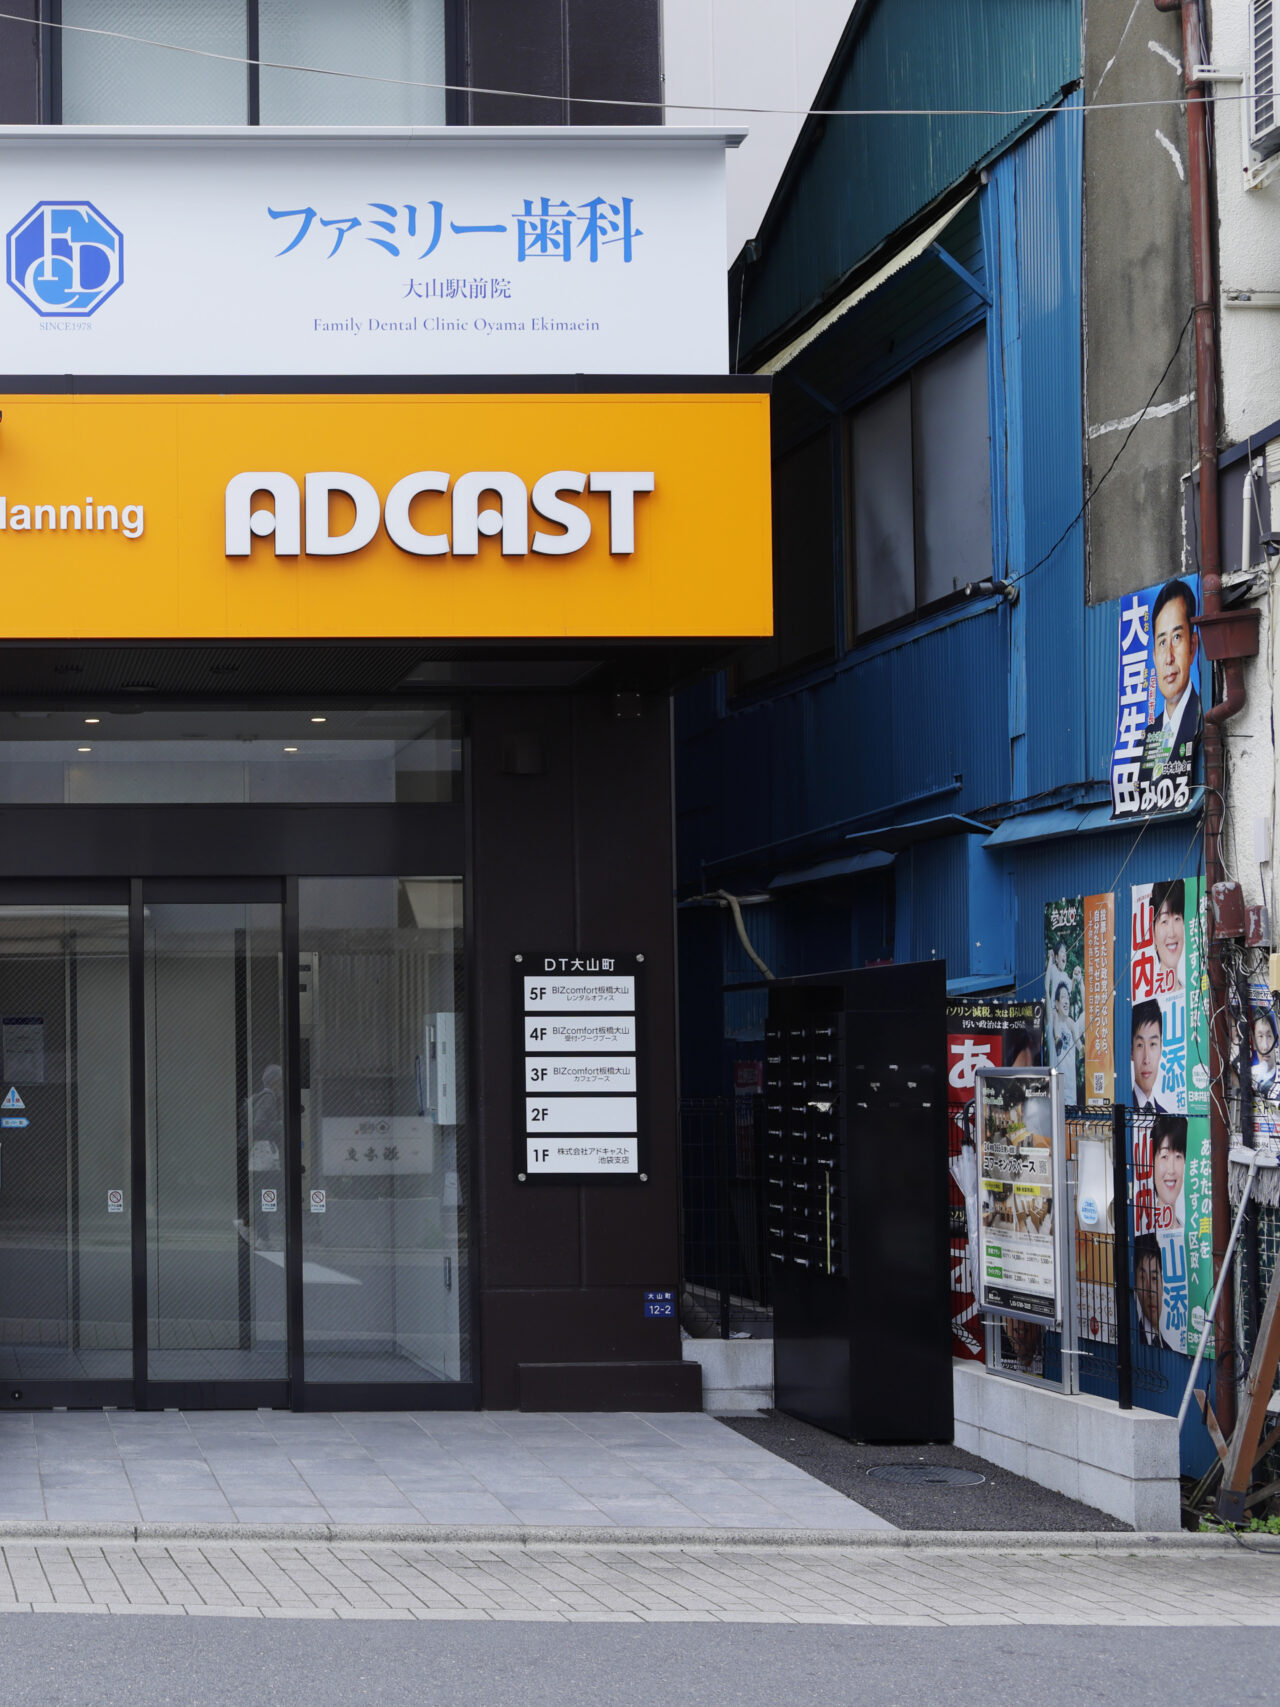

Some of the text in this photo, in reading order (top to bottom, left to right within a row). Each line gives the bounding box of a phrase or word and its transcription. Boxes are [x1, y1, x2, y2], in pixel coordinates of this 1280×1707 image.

[267, 196, 645, 264] ファミリー歯科
[402, 277, 512, 300] 大山駅前院
[39, 321, 93, 332] SINCE1978
[312, 318, 363, 336] Family
[367, 318, 418, 332] Dental
[422, 318, 469, 332] Clinic
[473, 319, 526, 336] Oyama
[224, 470, 656, 558] ADCAST
[1113, 595, 1149, 815] 大豆生田
[1140, 774, 1190, 812] みのる
[1050, 906, 1077, 931] 参政党
[1132, 901, 1154, 1002] 山内
[544, 958, 616, 972] DT大山町
[552, 986, 630, 995] BIZcomfort板橋大山
[1154, 968, 1175, 995] えり
[529, 987, 547, 1001] 5F
[530, 1027, 548, 1041] 4F
[552, 1027, 630, 1035] BIZcomfort板橋大山
[1160, 1001, 1186, 1095] 山添
[530, 1068, 548, 1081] 3F
[553, 1067, 631, 1076] BIZcomfort板橋大山
[1176, 1088, 1186, 1108] 拓
[531, 1108, 549, 1122] 2F
[533, 1149, 550, 1162] 1F
[557, 1148, 630, 1156] 株式会社アドキャスト
[598, 1156, 630, 1164] 池袋支店
[983, 1155, 1036, 1173] コワーキングスペース
[1134, 1132, 1153, 1234] 山内
[1154, 1203, 1173, 1229] えり
[1188, 1159, 1200, 1285] まっすぐ区政へ
[1162, 1238, 1187, 1331] 山添
[647, 1292, 672, 1300] 大山町
[650, 1304, 672, 1315] 12-2
